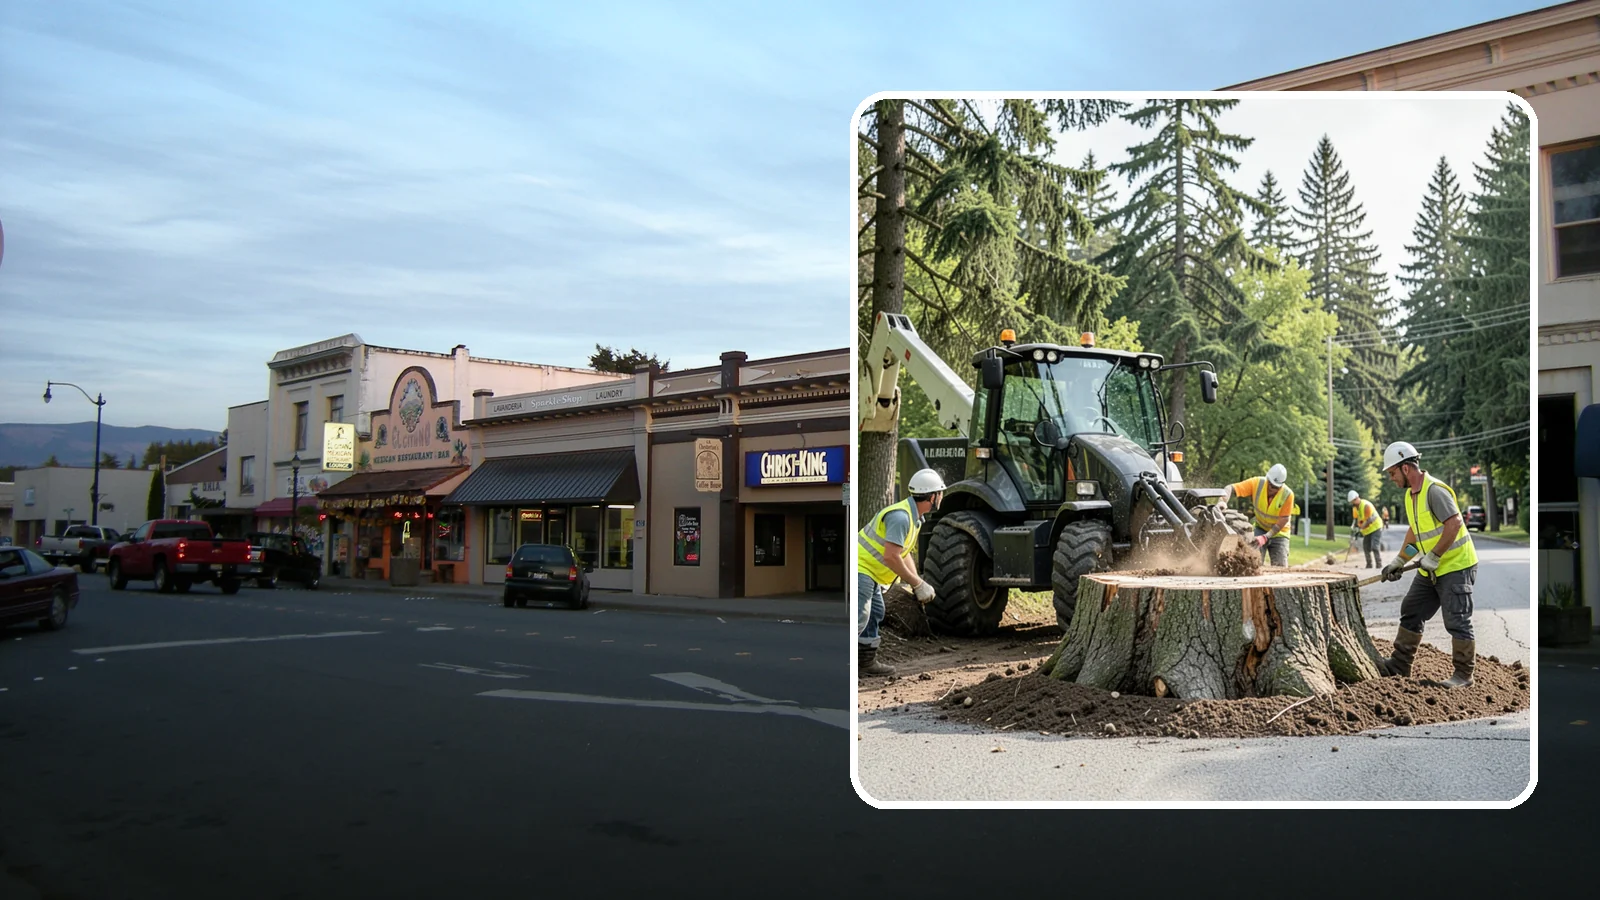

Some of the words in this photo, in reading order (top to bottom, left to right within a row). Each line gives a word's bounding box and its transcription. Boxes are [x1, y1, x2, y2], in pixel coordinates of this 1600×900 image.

[595, 389, 623, 400] LAUNDRY
[531, 396, 560, 409] Sparkle
[562, 394, 582, 406] Shop
[493, 402, 522, 413] LAVANDERIA
[398, 451, 433, 462] RESTAURANT
[438, 450, 450, 459] BAR
